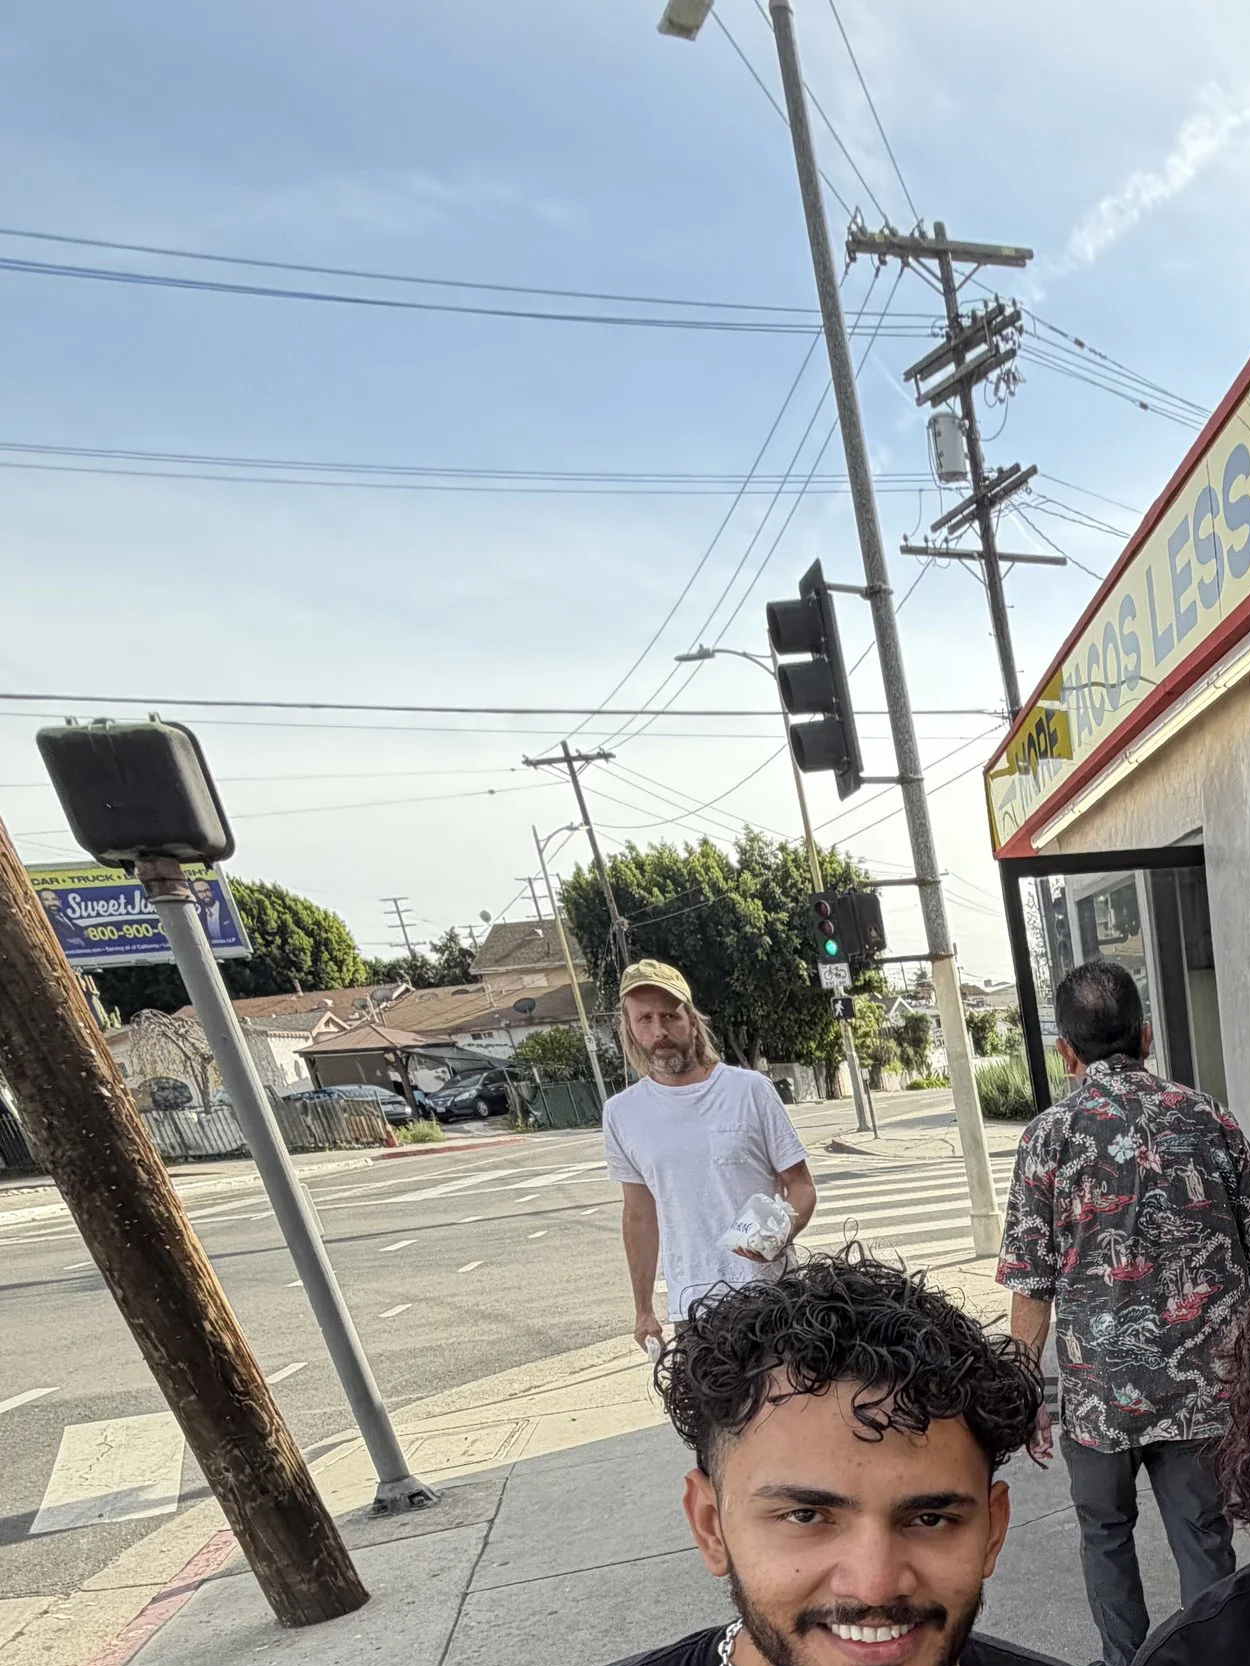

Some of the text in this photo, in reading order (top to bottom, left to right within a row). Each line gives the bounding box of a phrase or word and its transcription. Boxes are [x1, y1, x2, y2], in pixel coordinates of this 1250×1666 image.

[1014, 706, 1063, 818] MORE
[1060, 594, 1141, 748] TACOS
[32, 877, 60, 886] CAR
[68, 873, 116, 884] TRUCK
[66, 892, 127, 918] Sweet
